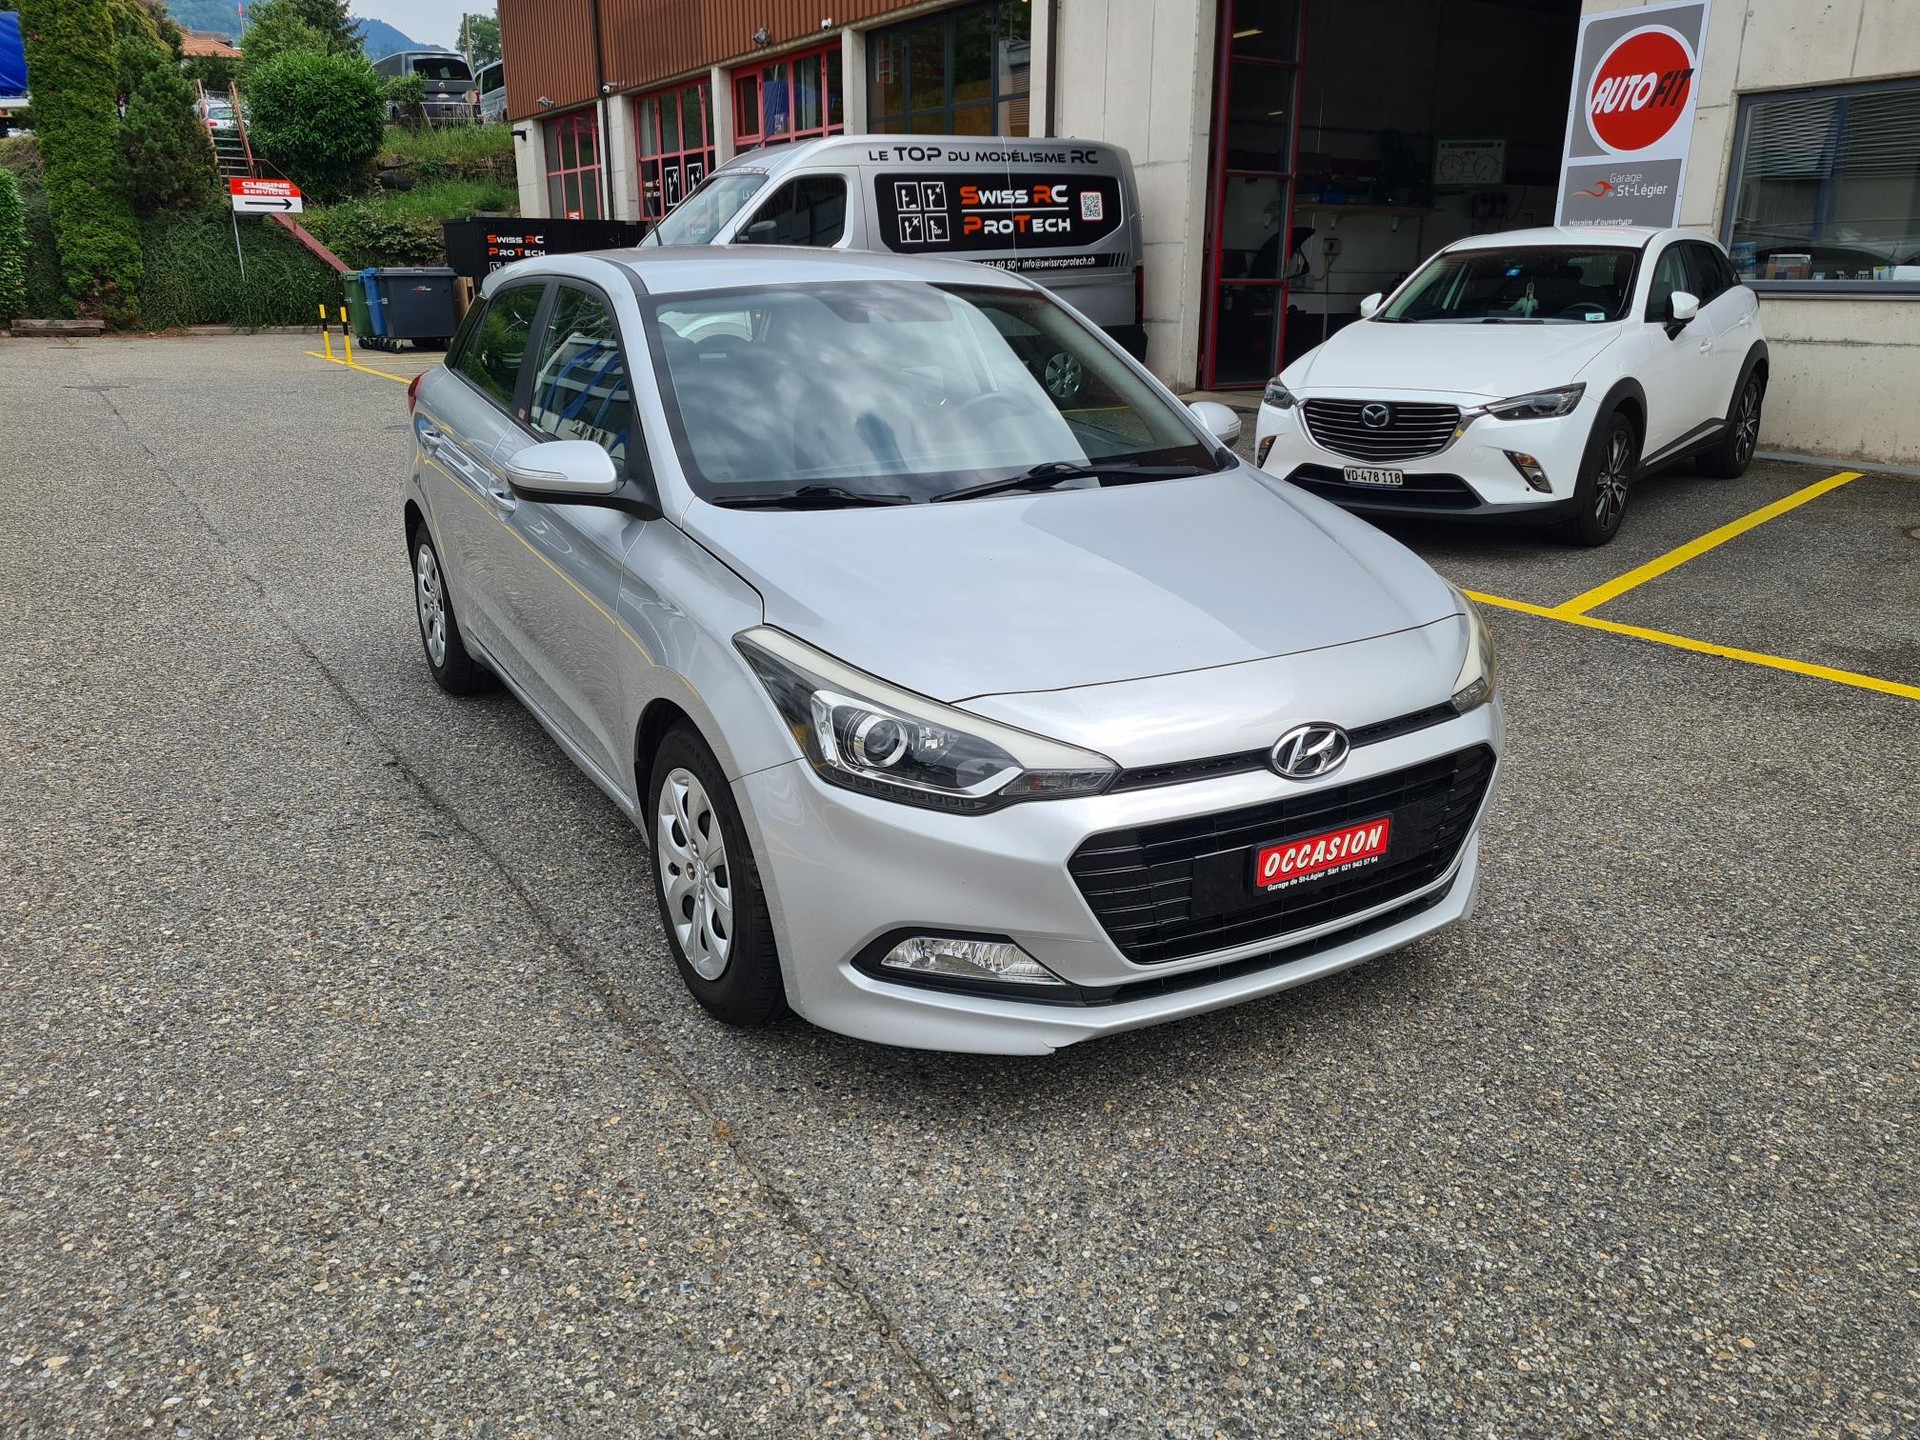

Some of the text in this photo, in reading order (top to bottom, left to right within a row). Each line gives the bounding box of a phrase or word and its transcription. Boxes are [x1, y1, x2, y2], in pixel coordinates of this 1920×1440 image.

[1591, 68, 1694, 114] AUTOFIT
[868, 147, 1098, 164] LE TOP DU MODÉLISME RC
[242, 181, 290, 189] CUISINE
[1610, 173, 1642, 184] Garage
[960, 185, 1069, 204] SWISS RC
[1617, 183, 1668, 198] St-Légier
[963, 214, 1071, 235] PROTECH
[487, 234, 544, 244] SWISS RC
[488, 247, 546, 257] PROTECH
[1007, 260, 1016, 269] 50
[1022, 256, 1096, 269] info@swissrcprotech.ch
[1264, 825, 1383, 876] OCCASION
[1267, 881, 1289, 892] Garage
[1298, 872, 1325, 883] St-Légier
[1341, 863, 1351, 872] 021
